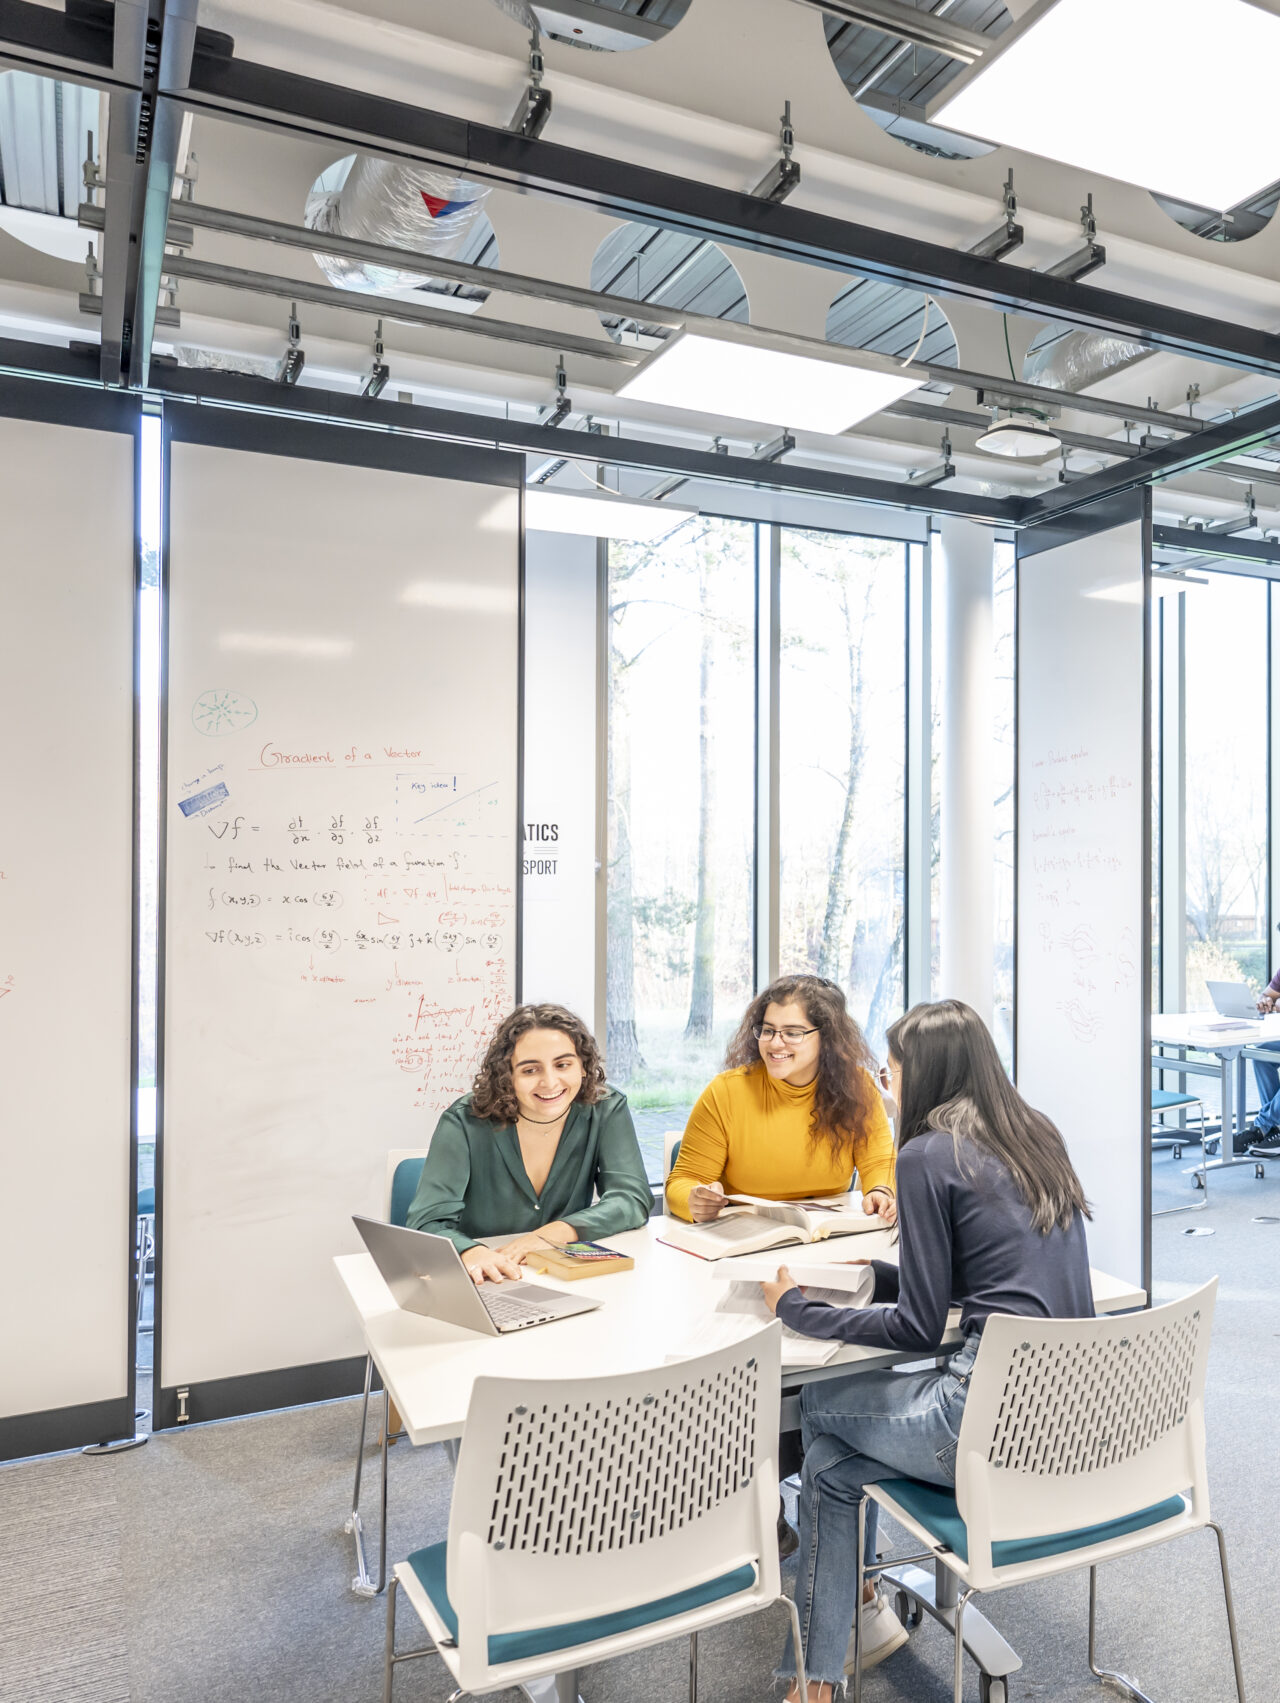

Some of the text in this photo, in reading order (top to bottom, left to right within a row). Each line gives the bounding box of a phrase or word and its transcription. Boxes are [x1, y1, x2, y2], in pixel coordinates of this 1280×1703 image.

[261, 743, 422, 767] Gradient of a Vector
[411, 782, 426, 793] Key
[264, 857, 285, 872] the
[289, 858, 326, 870] Vector
[373, 856, 385, 869] of
[523, 859, 558, 875] SPORT
